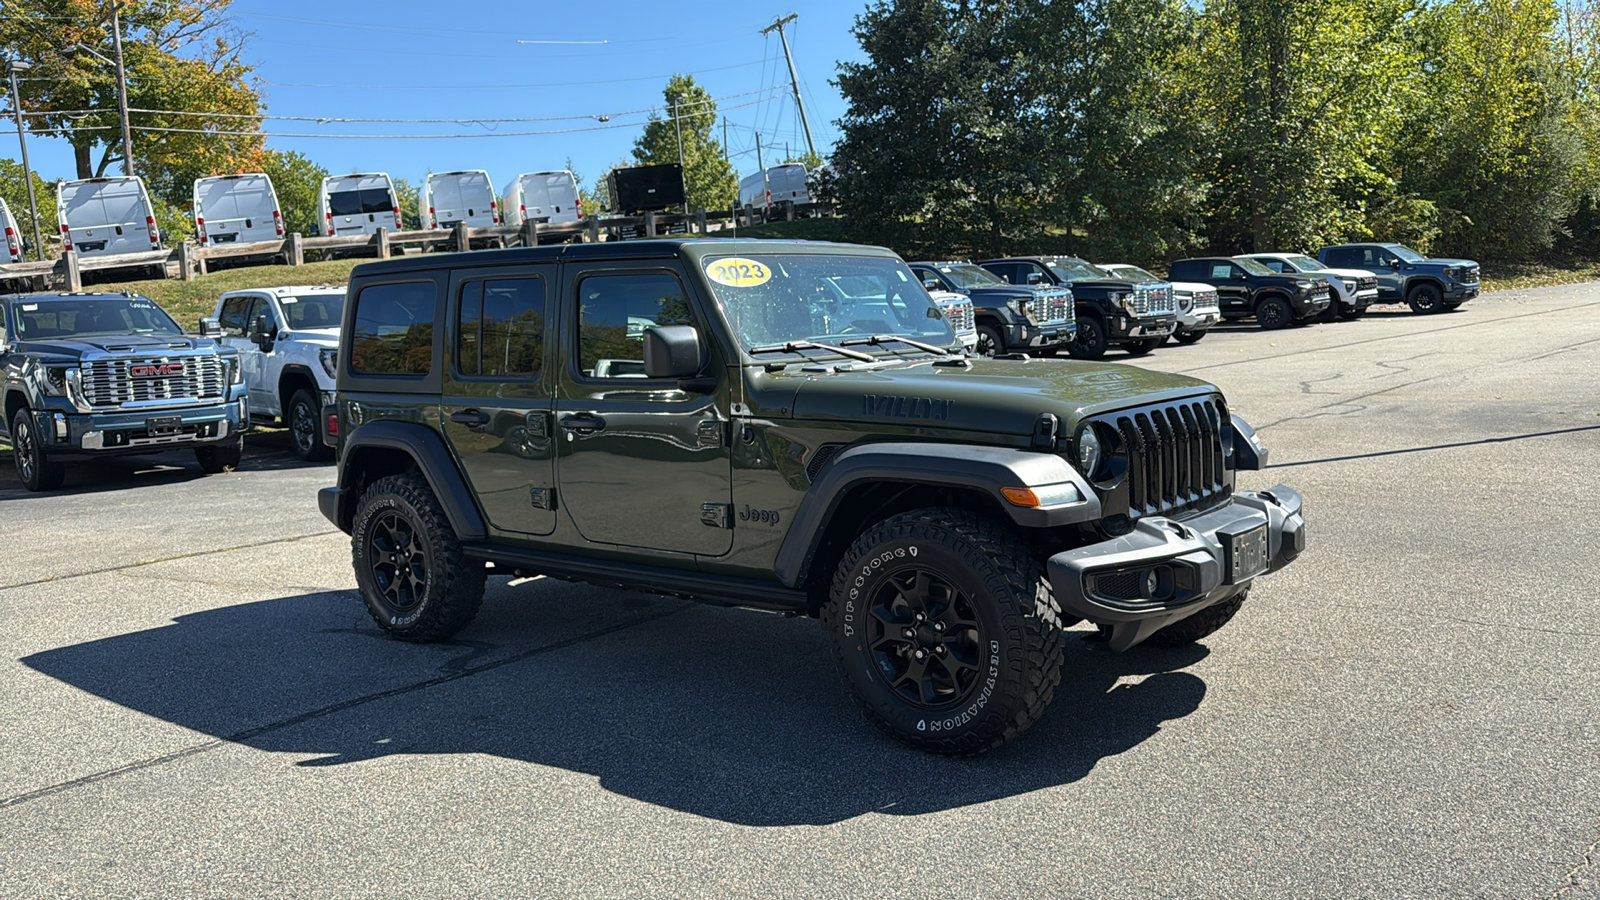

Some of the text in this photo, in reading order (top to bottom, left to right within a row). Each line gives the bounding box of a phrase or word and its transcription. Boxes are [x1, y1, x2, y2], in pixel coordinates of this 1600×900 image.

[714, 264, 765, 281] 2023
[132, 364, 183, 377] GMC
[739, 504, 780, 527] Jeep
[930, 640, 1000, 732] DESTINATION
